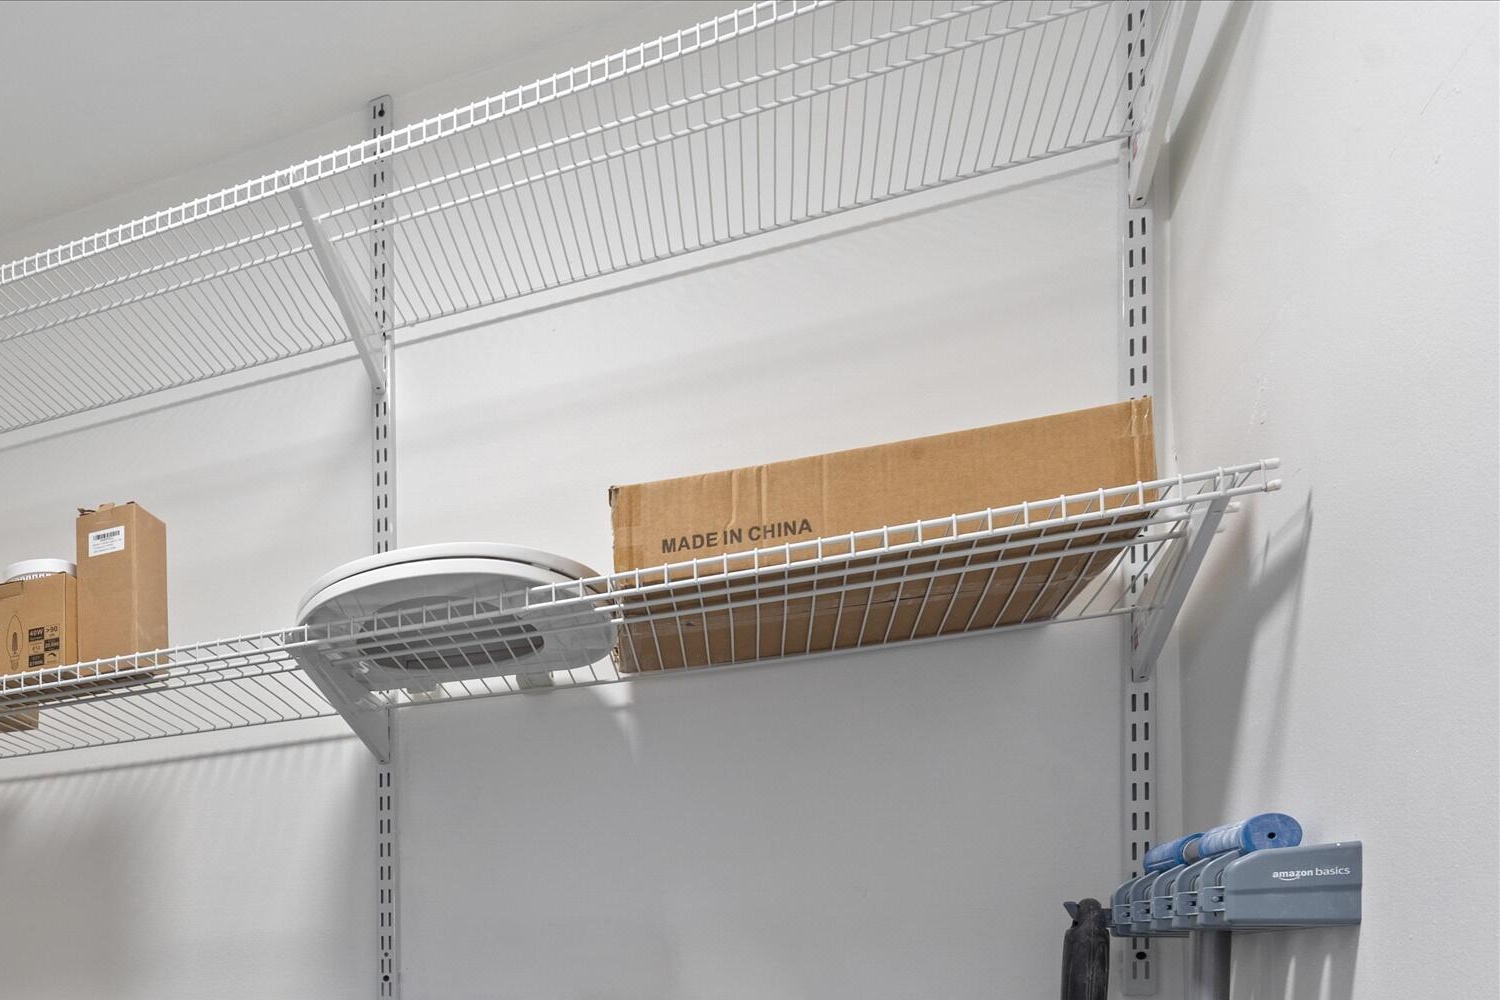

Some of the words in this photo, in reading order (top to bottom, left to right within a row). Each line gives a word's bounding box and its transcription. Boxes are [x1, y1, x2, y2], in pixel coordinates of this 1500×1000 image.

[662, 531, 718, 554] MADE
[723, 528, 742, 545] IN
[749, 518, 812, 541] CHINA
[1272, 869, 1313, 880] amazon
[1315, 866, 1350, 876] basics
